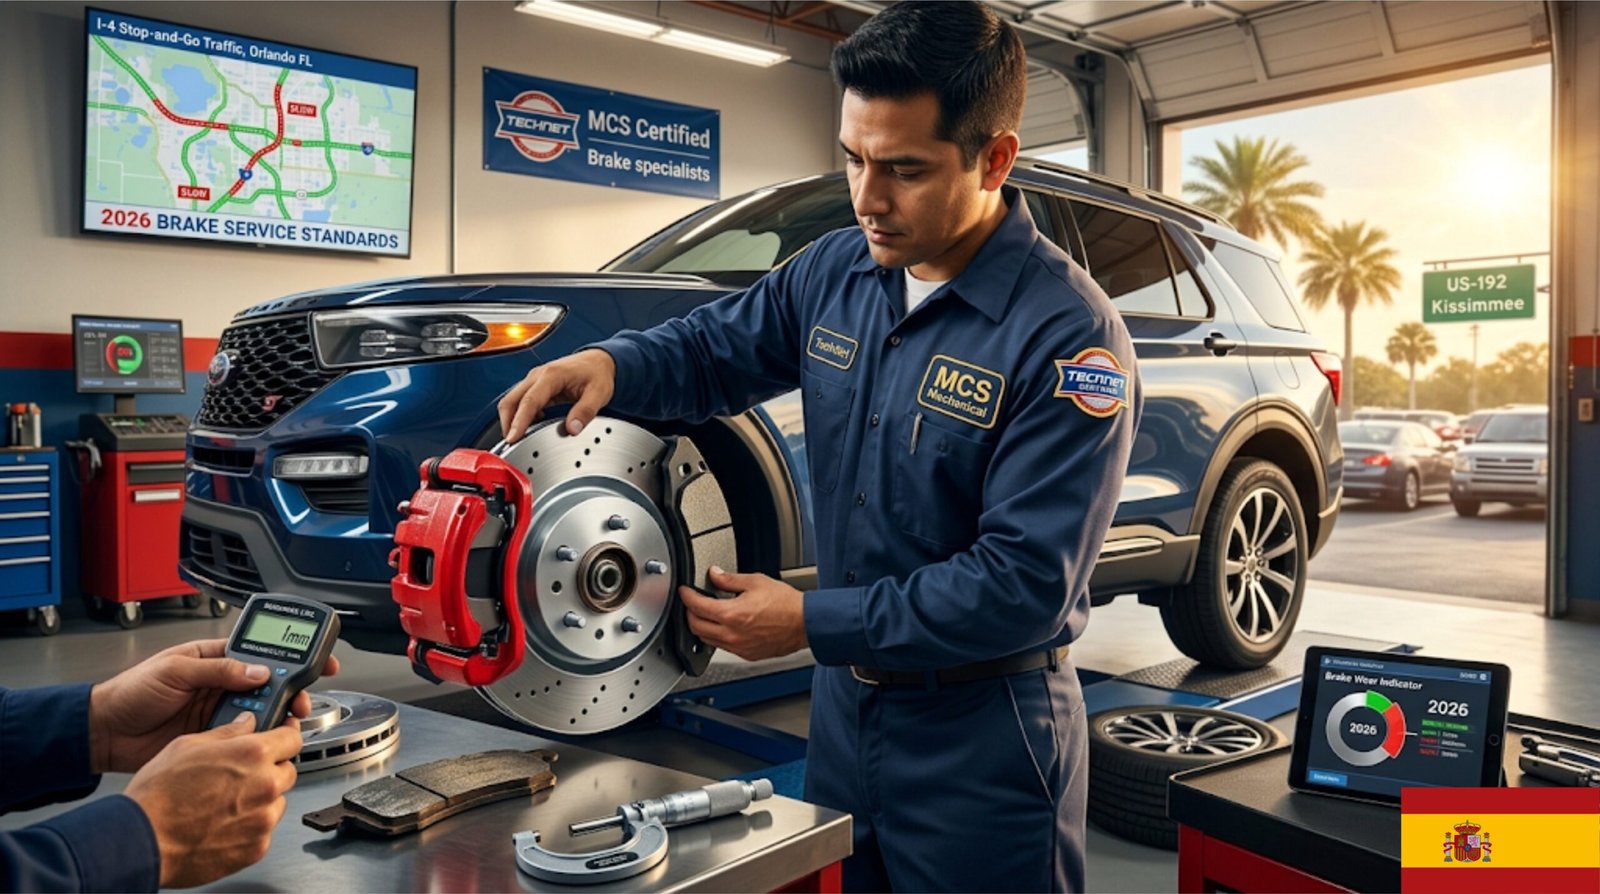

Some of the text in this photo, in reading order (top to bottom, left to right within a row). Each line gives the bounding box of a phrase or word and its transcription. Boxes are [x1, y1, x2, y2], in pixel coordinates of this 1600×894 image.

[97, 17, 313, 67] I-4 Stop-and-Go Traffic, Orlando FL
[588, 110, 710, 149] MCS Certified
[588, 149, 711, 182] Brake specialists
[181, 187, 208, 199] SLOW
[101, 208, 399, 249] 2026 BRAKE SERVICE STANDARDS
[1432, 274, 1525, 314] US-192 Kissimmee
[933, 365, 993, 404] MCS
[281, 624, 310, 646] 1mm
[1324, 671, 1353, 683] Brake
[1379, 678, 1423, 690] Indicator
[1427, 699, 1469, 717] 2026
[1349, 722, 1378, 736] 2026
